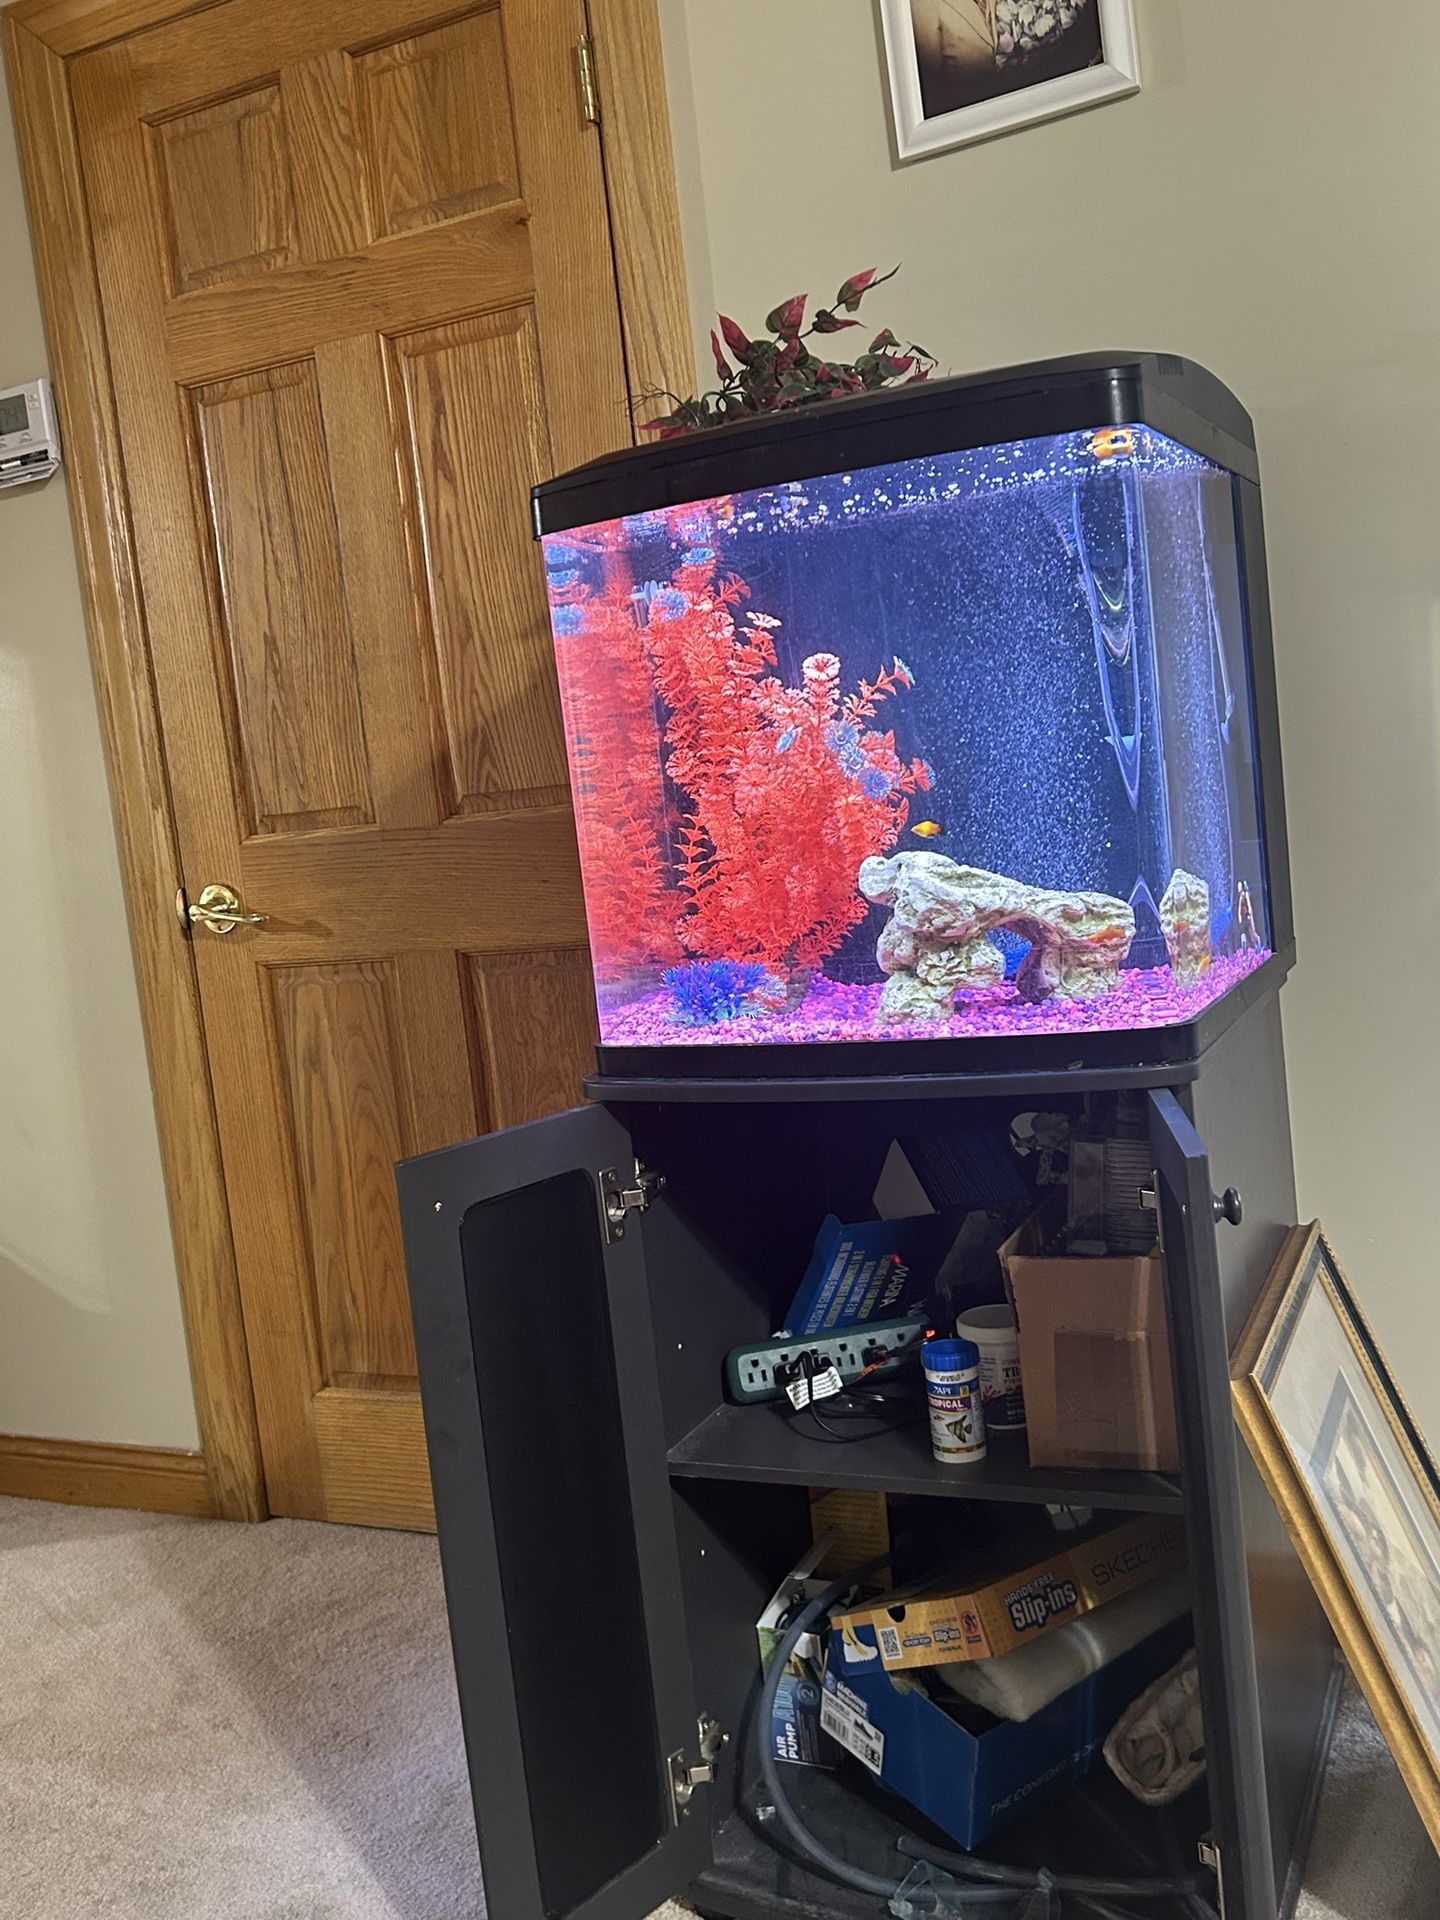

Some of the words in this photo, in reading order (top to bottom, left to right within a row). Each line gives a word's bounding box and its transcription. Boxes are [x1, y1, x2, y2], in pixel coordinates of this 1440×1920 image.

[879, 1264, 909, 1308] MARINA
[1003, 1584, 1034, 1606] HANDS
[1032, 1571, 1056, 1589] FREE
[1011, 1583, 1077, 1628] Slip-ins
[801, 1688, 814, 1699] 2
[776, 1735, 788, 1758] AIR
[785, 1722, 799, 1760] PUMP
